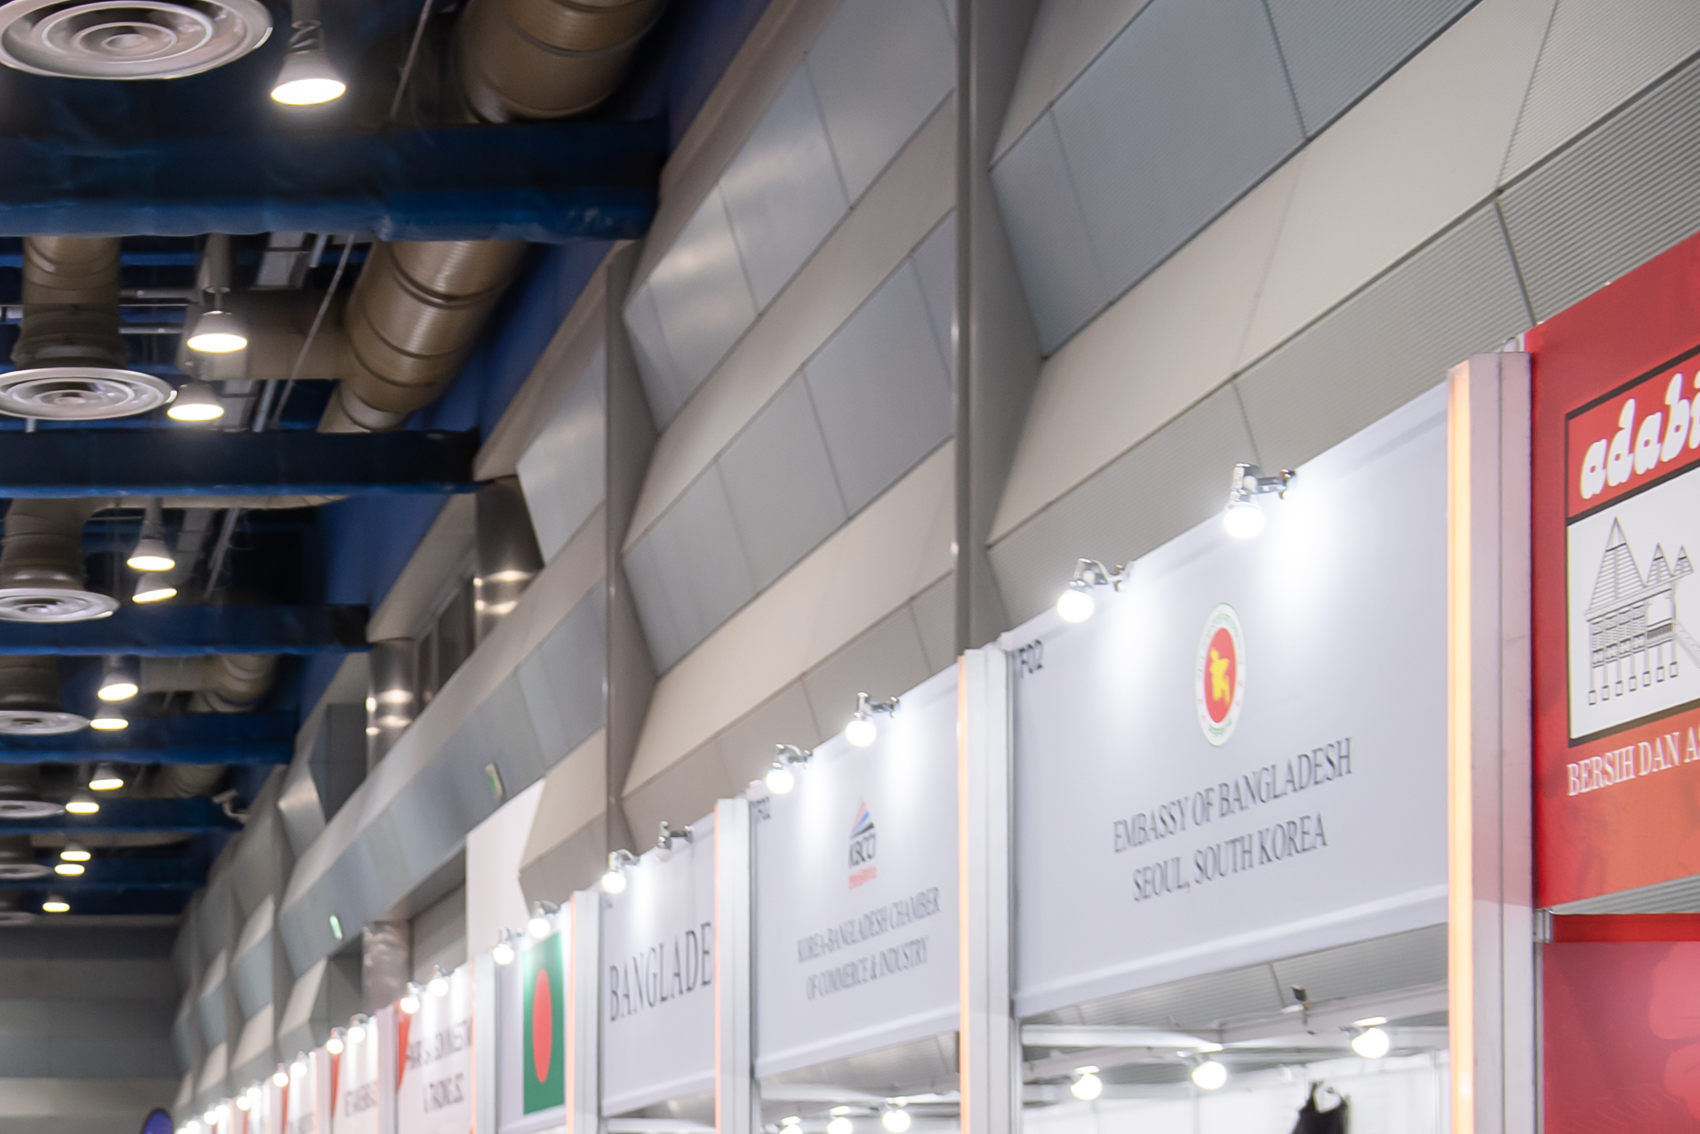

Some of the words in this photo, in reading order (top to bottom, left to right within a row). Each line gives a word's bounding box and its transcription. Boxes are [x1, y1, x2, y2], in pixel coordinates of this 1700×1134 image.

[1113, 796, 1189, 853] EMBASSY
[1192, 787, 1215, 826] OF
[1218, 737, 1352, 817] BANGLADESH
[1567, 748, 1635, 797] BERSIH
[1638, 731, 1680, 776] DAN
[1133, 856, 1190, 902] SEOUL,
[1194, 834, 1254, 884] SOUTH
[1258, 811, 1328, 865] KOREA
[609, 921, 712, 1022] BANGLADE
